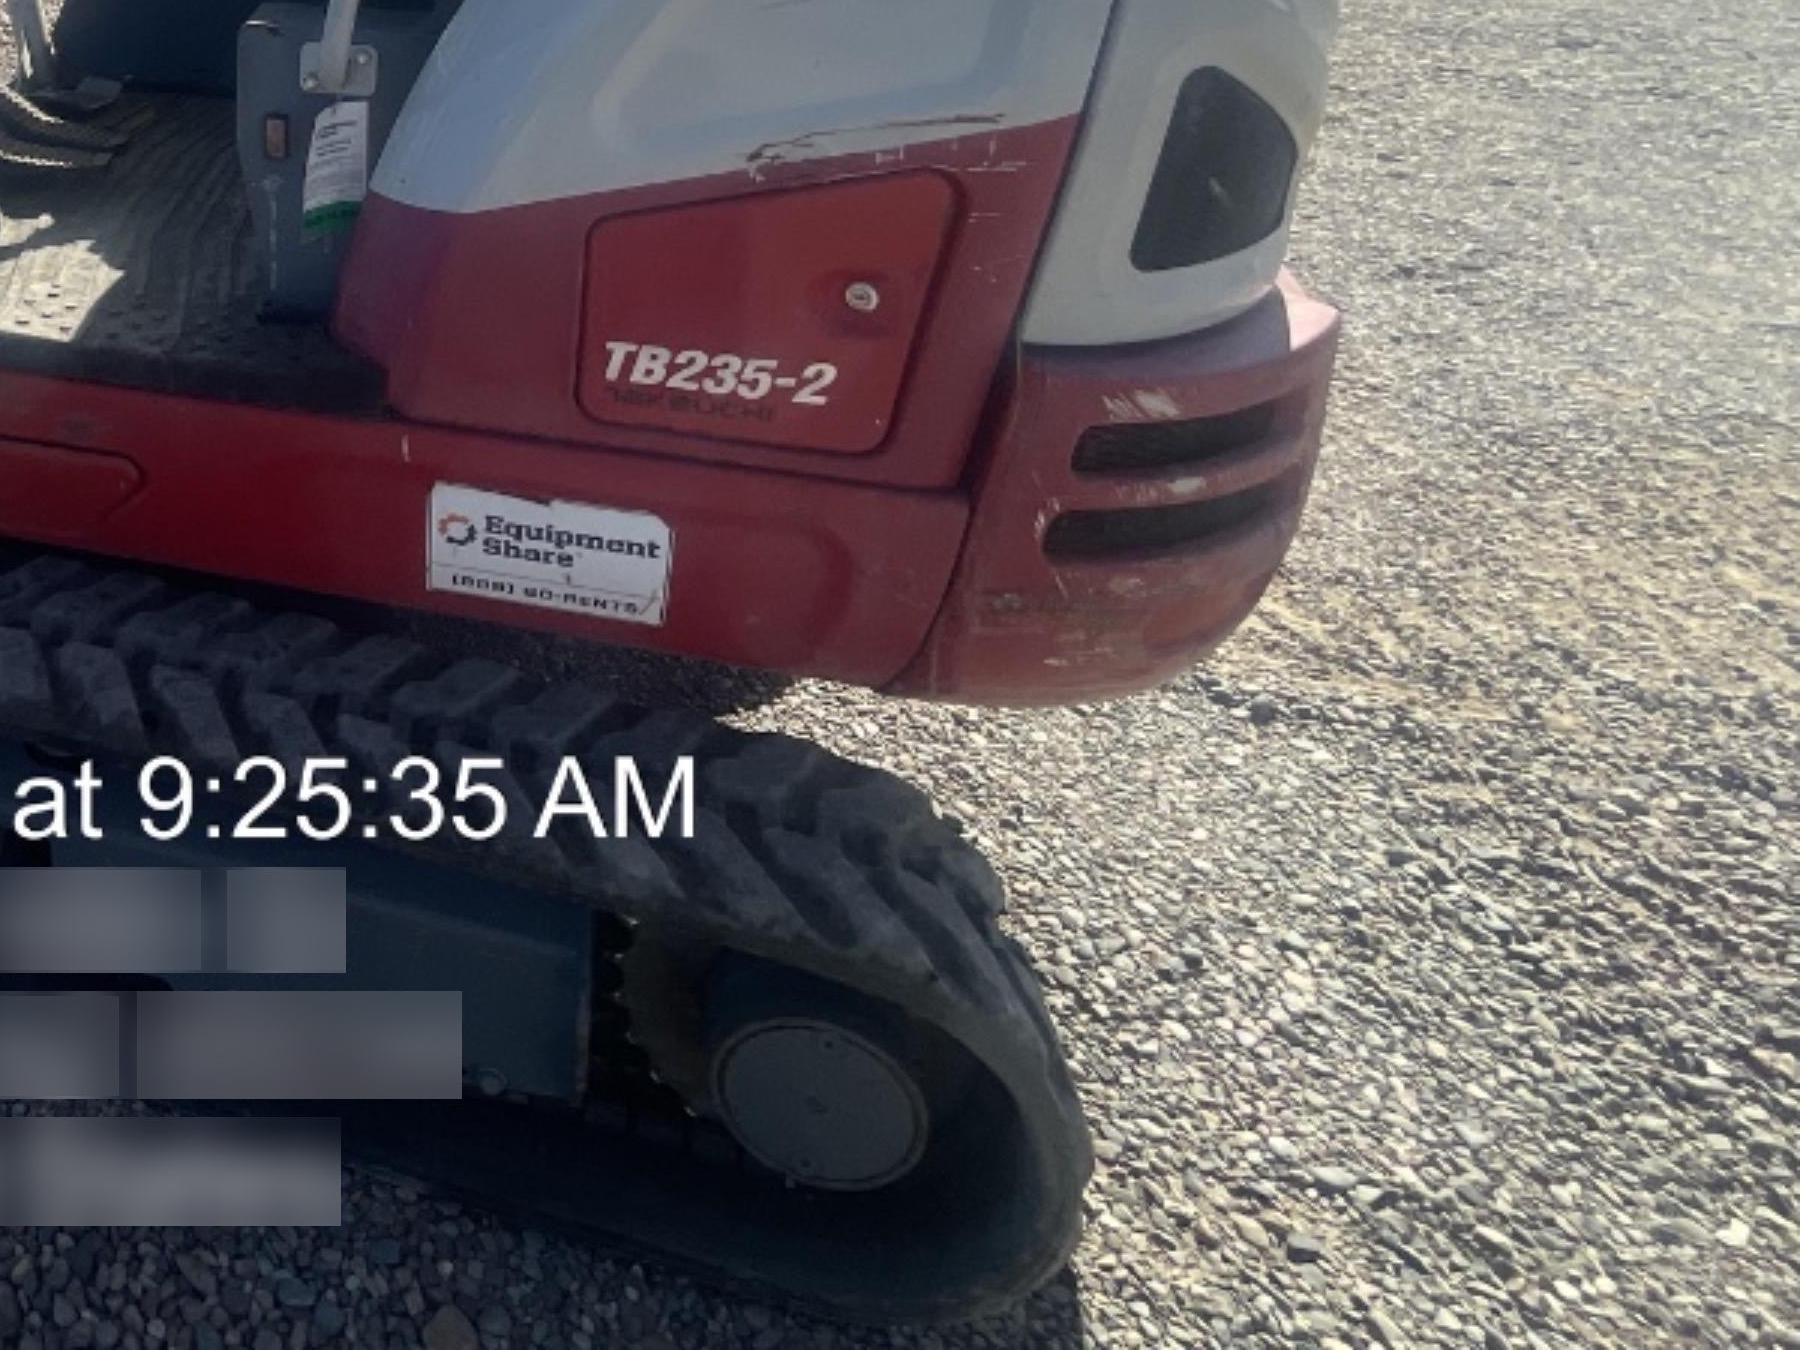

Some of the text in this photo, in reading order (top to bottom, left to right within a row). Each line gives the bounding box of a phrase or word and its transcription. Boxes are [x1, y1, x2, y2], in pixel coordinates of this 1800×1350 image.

[604, 340, 839, 407] TB235-2
[482, 536, 574, 568] Share
[483, 514, 662, 559] Equipment
